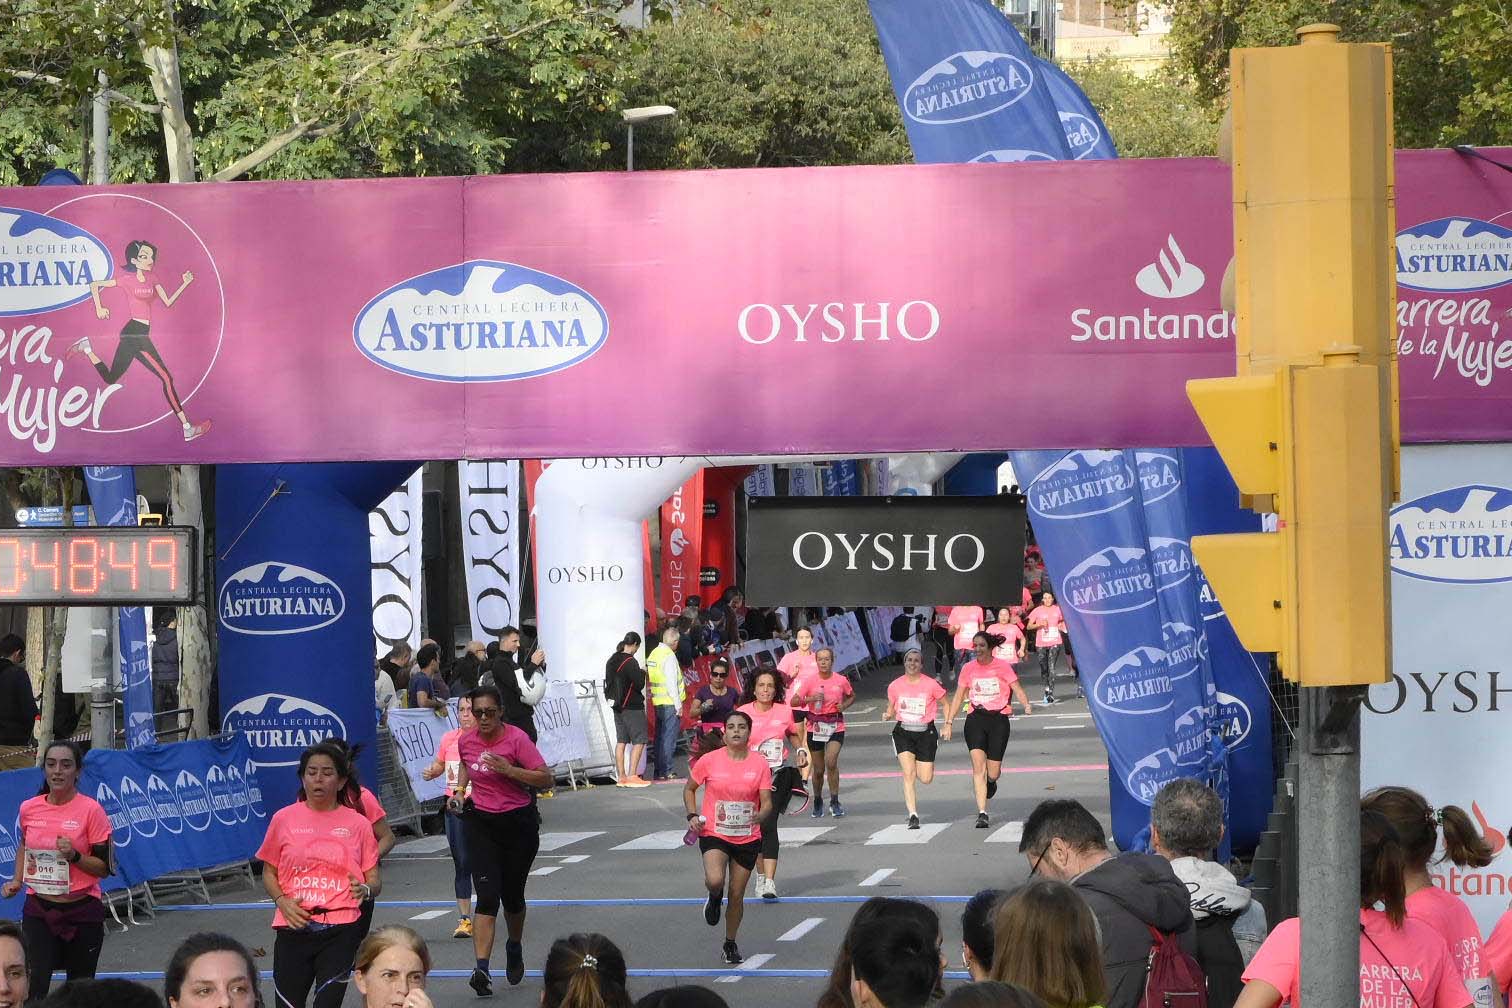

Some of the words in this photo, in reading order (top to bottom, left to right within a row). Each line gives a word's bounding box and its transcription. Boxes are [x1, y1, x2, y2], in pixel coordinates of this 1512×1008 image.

[16, 243, 89, 256] LECHERA
[1410, 243, 1463, 251] CENTRAL
[1466, 242, 1512, 250] LECHER
[1395, 245, 1512, 274] ASTURIAN
[412, 303, 491, 316] CENTRAL
[499, 301, 581, 314] LECHERA
[1396, 298, 1492, 327] arrera
[373, 307, 589, 352] ASTURIANA
[737, 300, 941, 345] OYSHO
[1071, 307, 1236, 341] Santand
[1419, 331, 1437, 356] la
[1433, 320, 1512, 387] Muje
[1417, 519, 1485, 530] CENTRAL
[792, 532, 985, 573] OYSHO
[1389, 522, 1512, 560] ASTURI
[548, 565, 624, 585] OYSHO
[235, 587, 277, 596] CENTRAL
[282, 586, 332, 595] LECHERA
[223, 591, 336, 619] ASTURIANA
[1363, 671, 1512, 715] OYSH
[238, 719, 278, 727] CENTRAL
[282, 718, 332, 727] LECHERA
[293, 876, 343, 892] DORSAL
[1360, 963, 1423, 982] ARRERA
[1363, 979, 1384, 995] DE
[1390, 982, 1410, 996] LA
